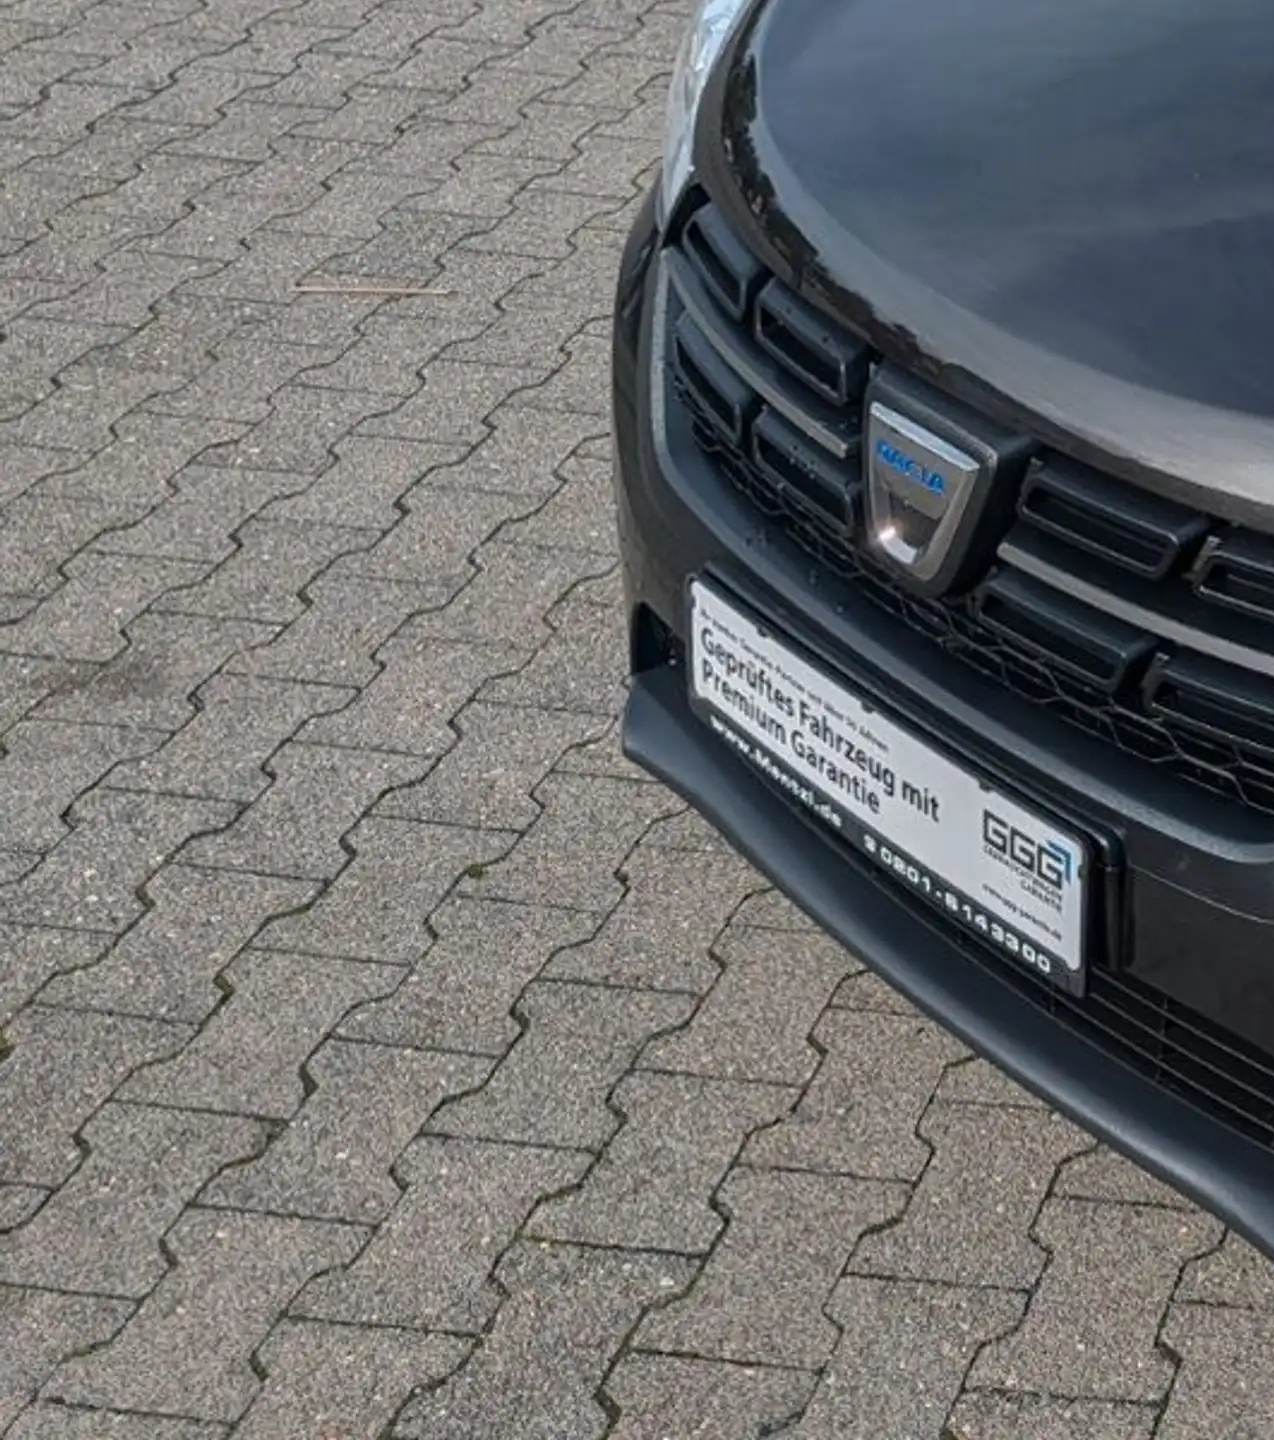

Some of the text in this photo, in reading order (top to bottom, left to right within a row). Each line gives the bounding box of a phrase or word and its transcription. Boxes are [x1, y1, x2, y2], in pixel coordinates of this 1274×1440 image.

[701, 627, 941, 823] Geprüftes Fahrzeug mit
[703, 659, 881, 816] Premium Garantie
[982, 808, 1064, 891] GGG
